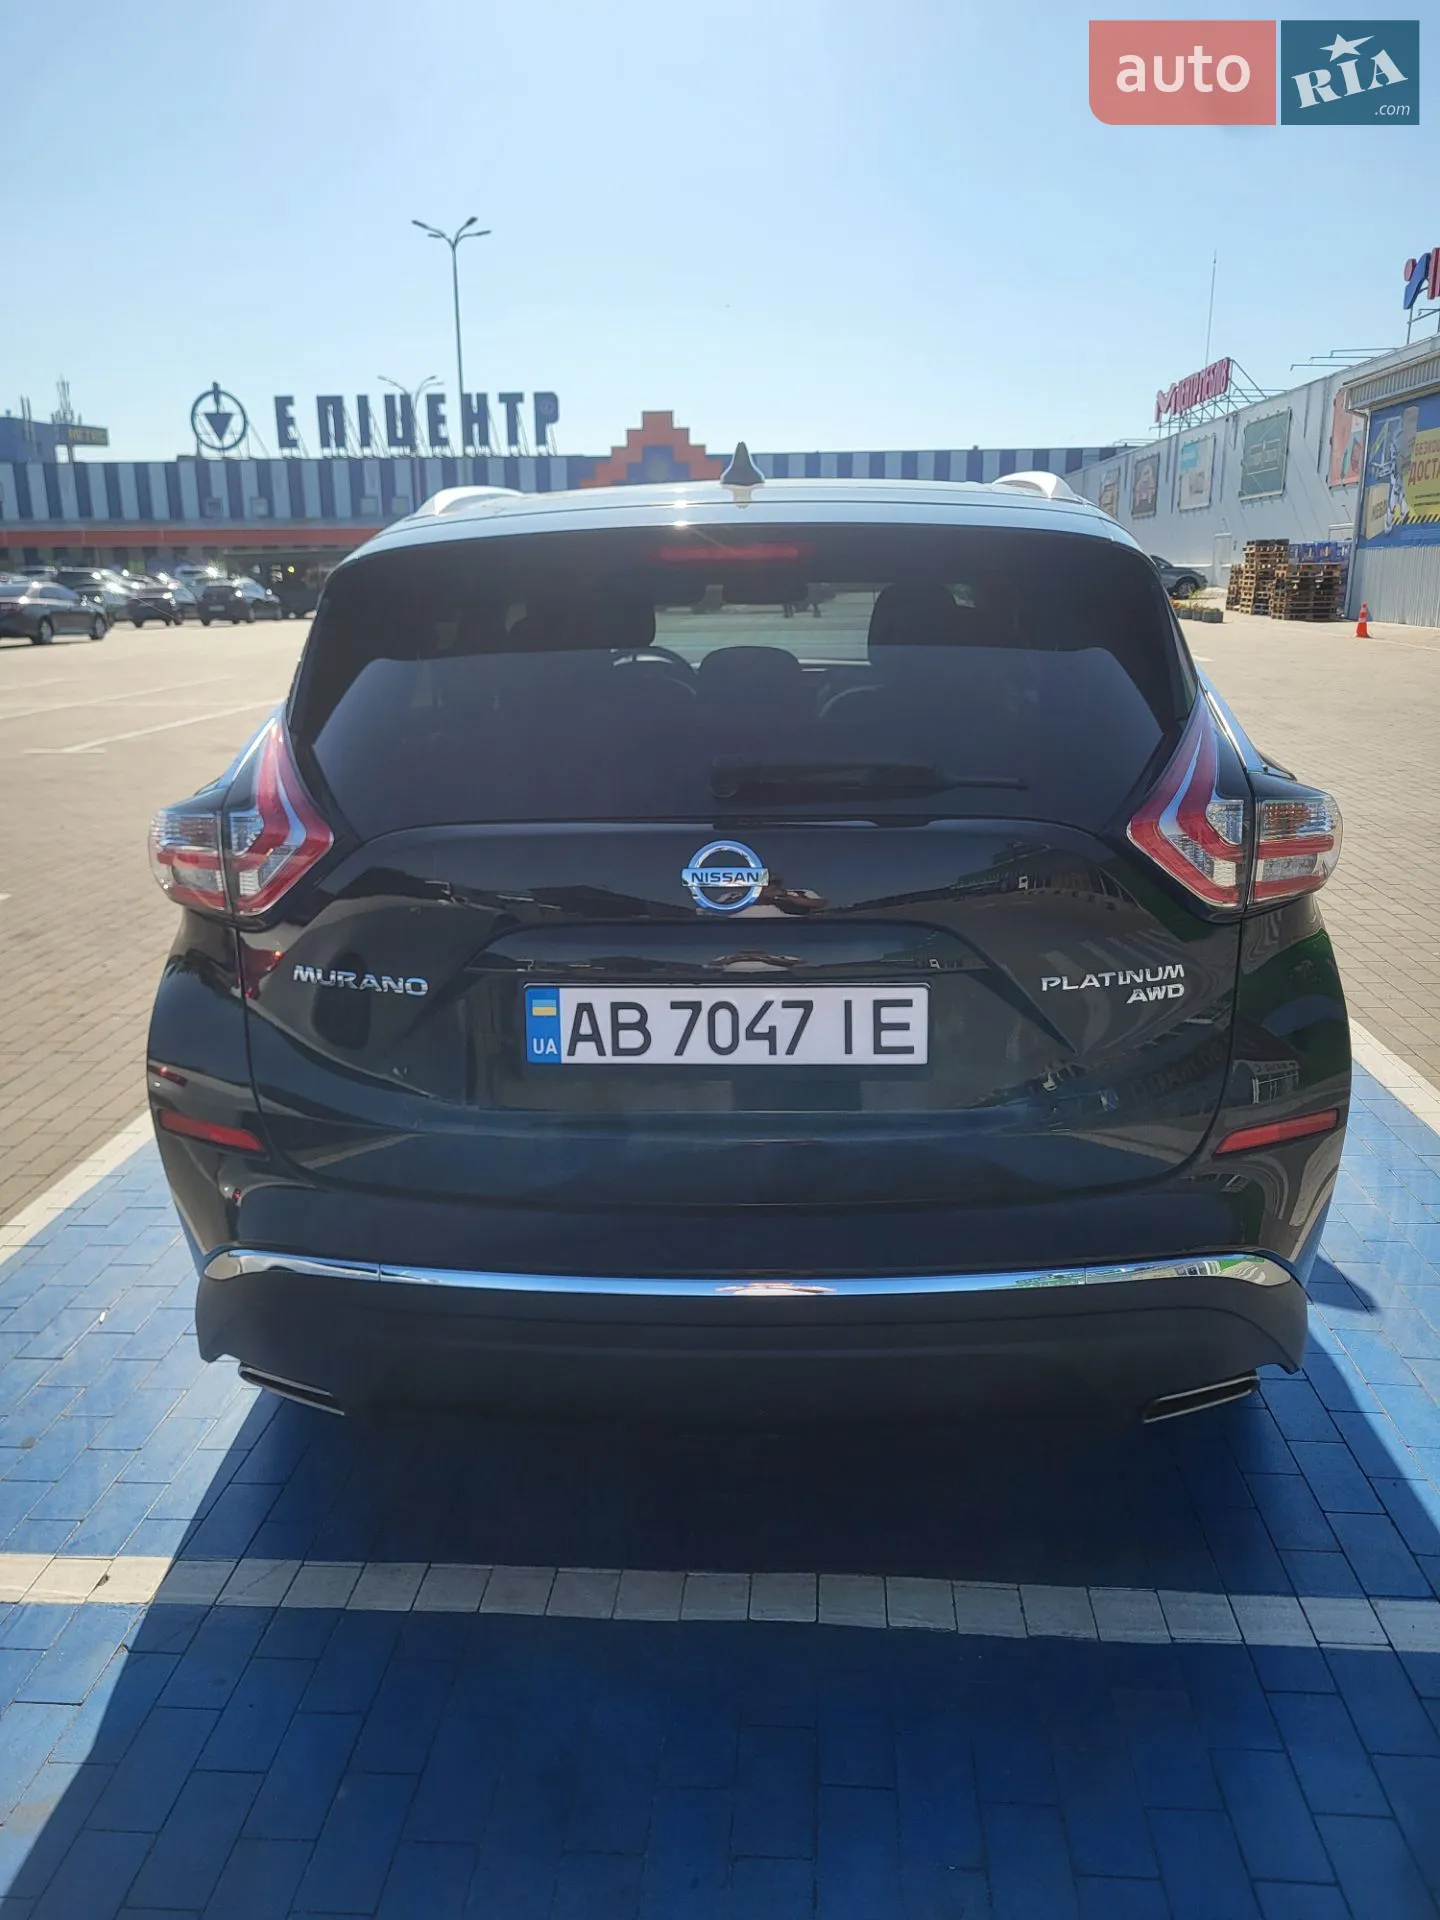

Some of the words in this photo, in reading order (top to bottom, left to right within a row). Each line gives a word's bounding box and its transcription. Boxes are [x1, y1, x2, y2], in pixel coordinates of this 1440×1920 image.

[273, 391, 560, 450] ЕПІЦЕНТР
[690, 870, 760, 885] NISSAN
[292, 964, 429, 997] MURANO
[1040, 963, 1186, 992] PLATINUM
[1126, 983, 1185, 1004] AWD
[566, 1001, 653, 1057] AB
[669, 999, 815, 1057] 7047
[843, 998, 915, 1056] IE
[532, 1036, 559, 1056] UA
